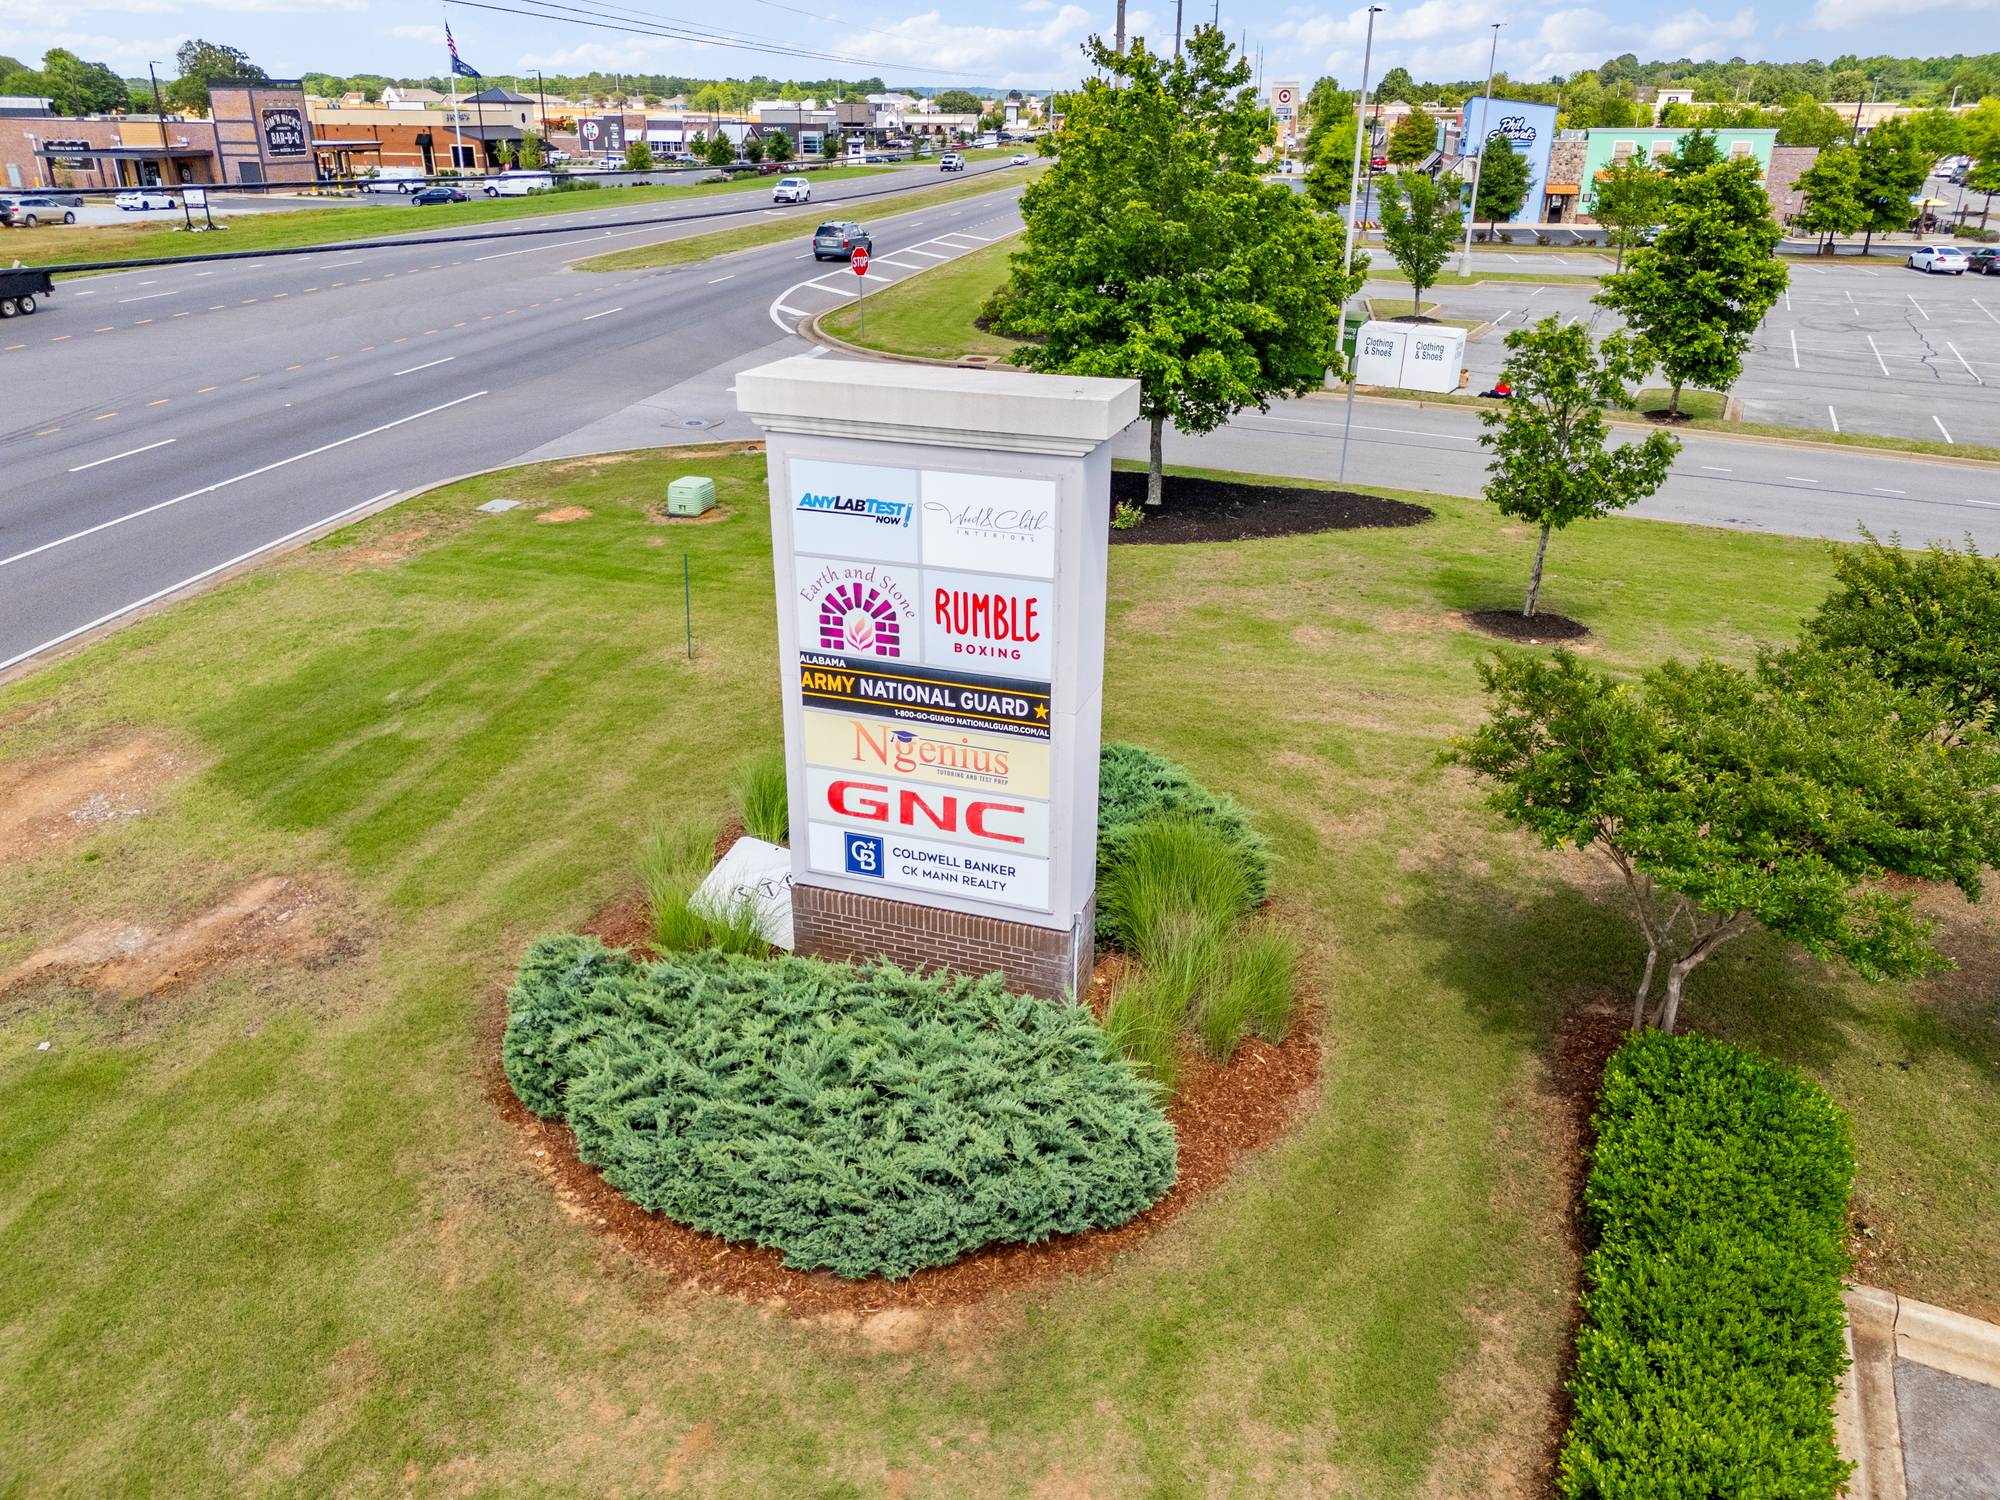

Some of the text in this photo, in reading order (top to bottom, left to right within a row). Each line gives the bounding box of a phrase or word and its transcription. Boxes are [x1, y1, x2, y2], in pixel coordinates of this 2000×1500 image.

[1500, 117, 1525, 132] Phil
[270, 132, 300, 144] BAR-B-Q
[1488, 127, 1536, 142] Sdoval's
[853, 256, 867, 267] STOP
[1365, 337, 1393, 350] Clothing
[1416, 341, 1444, 354] Clothing
[1364, 347, 1392, 357] & Shoes
[1422, 352, 1442, 361] Shoes
[875, 516, 901, 525] NOW
[957, 530, 1034, 542] INTERIORS
[800, 566, 915, 618] Earth and Stone
[935, 588, 1040, 642] RUMBLE
[954, 642, 1021, 660] BOXING
[800, 654, 846, 668] ALABAMA
[801, 671, 1029, 717] ARMY NATIONAL GUARD
[895, 709, 1049, 737] 1-800-GO-GUARD NATIONALGUARD.COM/AL
[849, 719, 1009, 775] Ngenius
[937, 769, 964, 778] TUTORING
[827, 780, 1025, 844] GNC
[893, 847, 1016, 877] COLDWELL BANKER
[902, 865, 1007, 891] CK MANN REALTY
